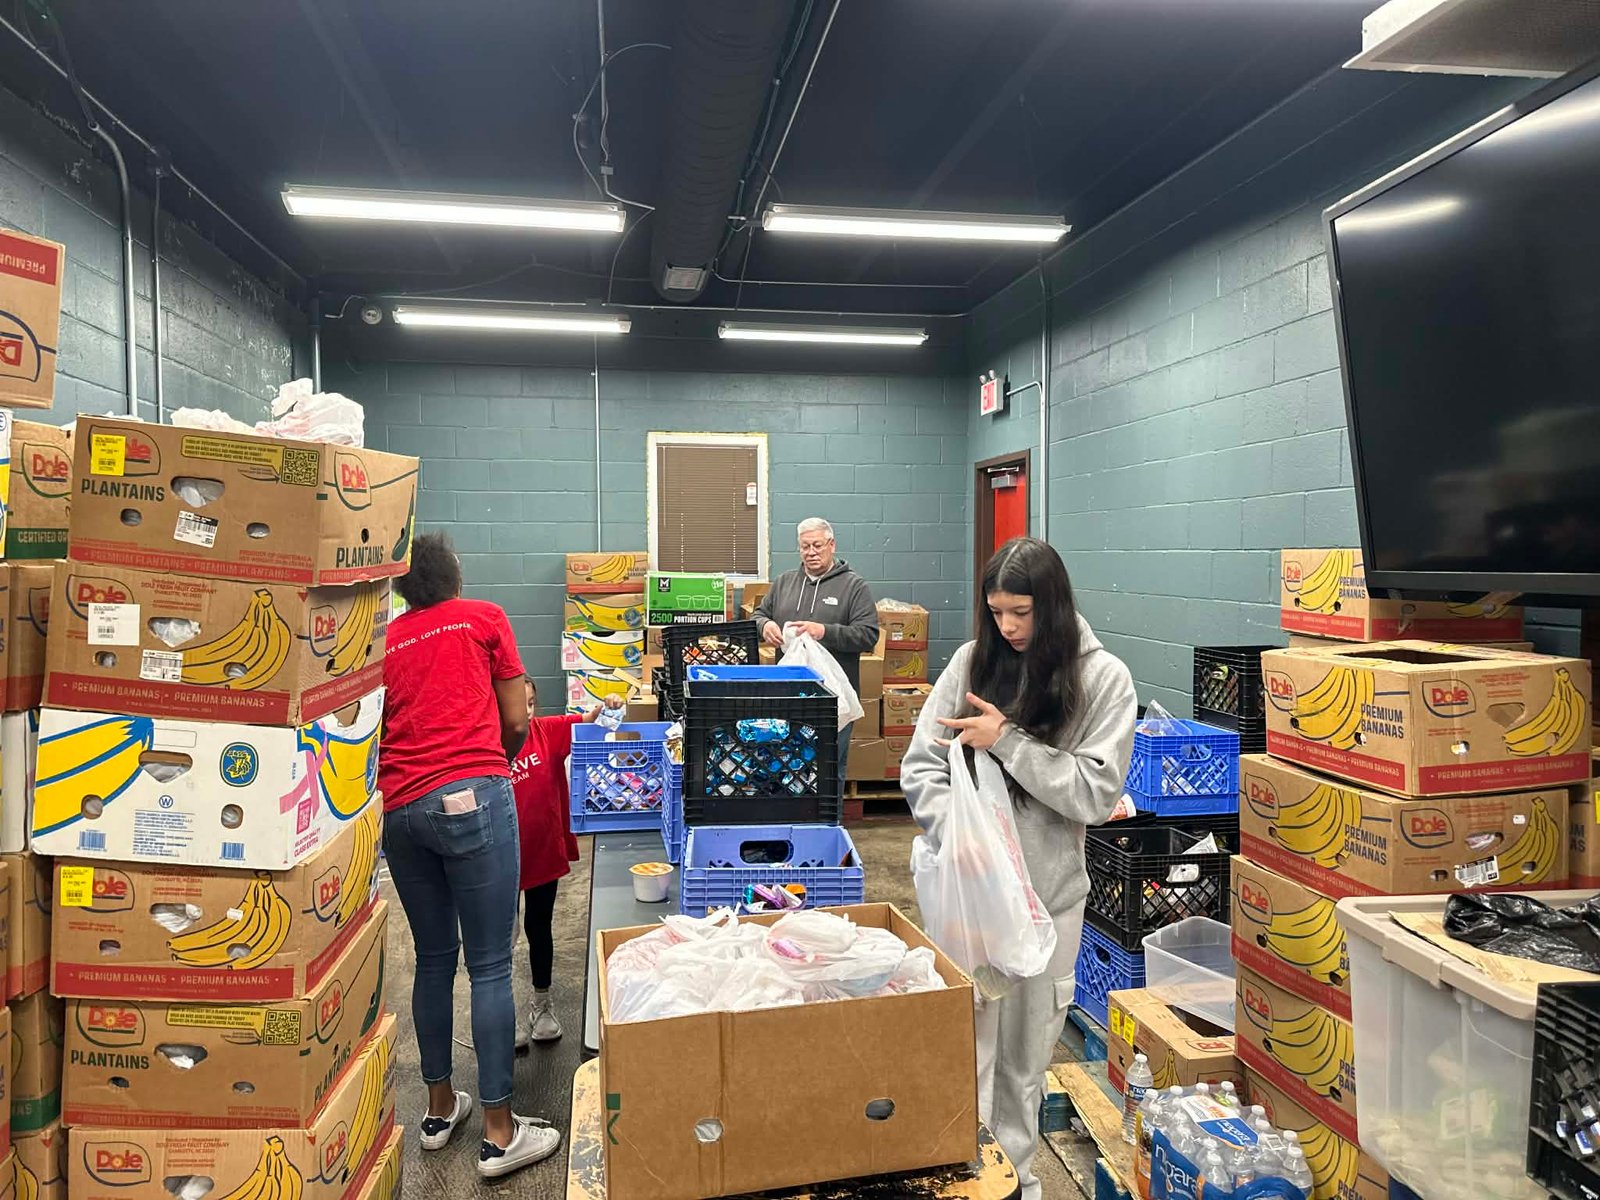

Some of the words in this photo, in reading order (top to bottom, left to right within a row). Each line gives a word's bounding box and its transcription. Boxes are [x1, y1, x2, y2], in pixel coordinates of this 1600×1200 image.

[32, 454, 69, 477] Dole
[340, 464, 368, 490] Dole
[81, 478, 165, 502] PLANTAINS
[18, 531, 57, 544] CERTIFIED
[335, 545, 385, 569] PLANTAINS
[660, 578, 670, 587] M
[1286, 566, 1301, 580] Dole
[1339, 576, 1366, 587] PREMIUM
[77, 583, 127, 605] Dole
[1338, 588, 1366, 599] BANANAS
[314, 611, 337, 637] Dole
[651, 613, 672, 623] 2500
[674, 615, 697, 624] PORTION
[697, 615, 712, 623] CUPS
[397, 637, 418, 649] GOD.
[420, 627, 440, 640] LOVE
[71, 681, 115, 694] PREMIUM
[117, 685, 161, 698] BANANAS
[174, 691, 218, 704] PREMIUM
[221, 694, 265, 708] BANANAS
[1270, 676, 1293, 696] Dole
[1431, 686, 1469, 704] Dole
[1361, 702, 1403, 723] PREMIUM
[1360, 719, 1404, 739] BANANAS
[1437, 769, 1471, 780] PREMIUM
[1251, 782, 1275, 805] Dole
[1411, 815, 1447, 834] Dole
[1344, 824, 1387, 850] PREMIUM
[1343, 838, 1387, 866] BANANAS
[93, 875, 128, 896] ole
[319, 875, 341, 905] Dole
[1241, 883, 1269, 910] Dole
[78, 971, 121, 982] PREMIUM
[123, 973, 166, 984] BANANAS
[180, 976, 224, 986] PREMIUM
[226, 976, 270, 986] BANANAS
[321, 988, 341, 1026] Dole
[1245, 988, 1270, 1017] Dole
[87, 1005, 138, 1029] Dole
[71, 1049, 150, 1070] PLANTAINS
[1339, 1058, 1356, 1080] PRE
[95, 1149, 143, 1170] Dole
[326, 1129, 346, 1168] Dole
